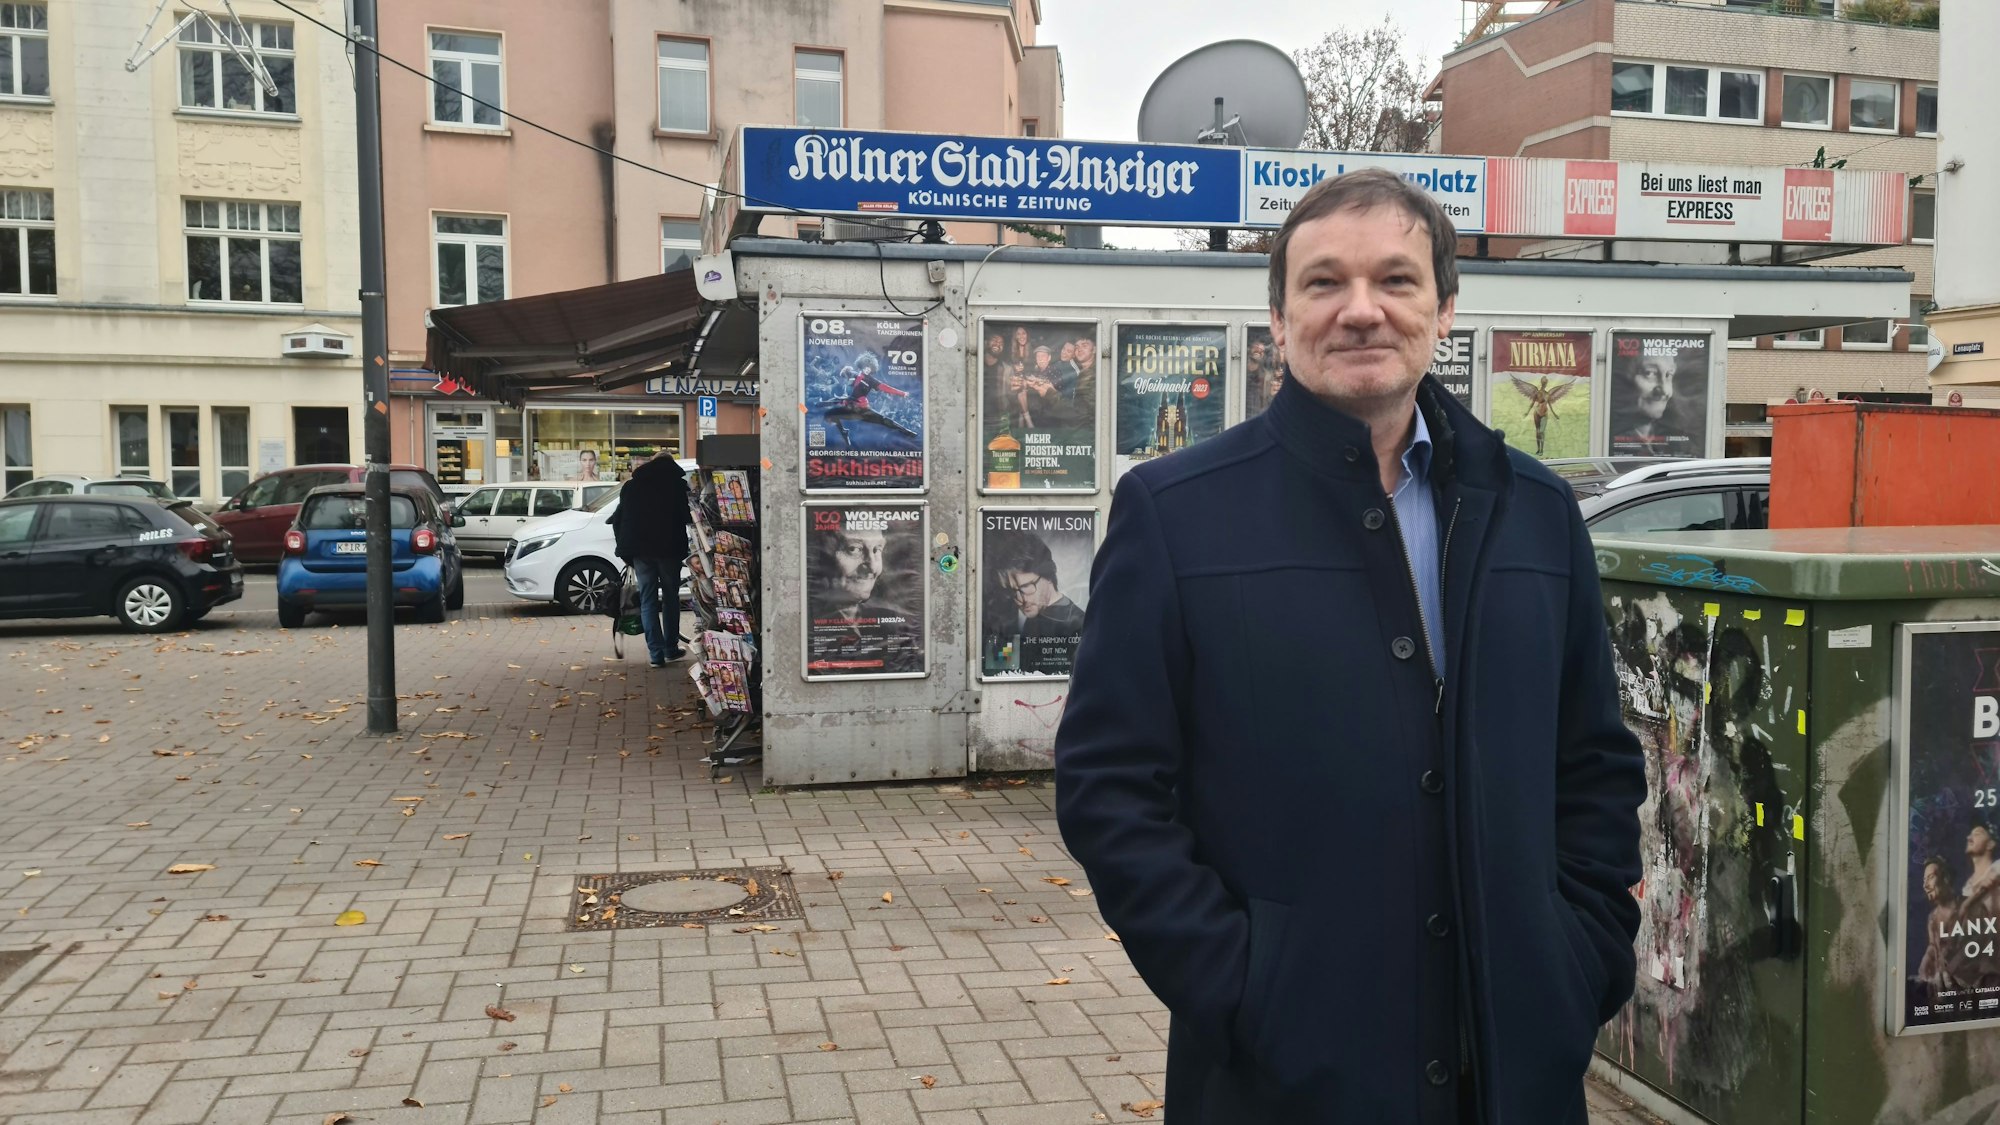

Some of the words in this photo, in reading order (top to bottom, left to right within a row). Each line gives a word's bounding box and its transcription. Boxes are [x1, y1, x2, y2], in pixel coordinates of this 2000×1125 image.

[789, 134, 927, 184] Kölner
[931, 140, 1199, 198] Stadt-Anzeiger
[1254, 160, 1326, 187] Kiosk
[1641, 172, 1663, 192] Bei
[1668, 177, 1692, 192] uns
[1697, 174, 1728, 194] liest
[1733, 179, 1762, 194] man
[908, 190, 1007, 208] KÖLNISCHE
[1017, 195, 1092, 211] ZEITUNG
[1567, 178, 1615, 215] EXPRESS
[1259, 197, 1298, 211] Zeitu
[1786, 185, 1832, 221] EXPRESS
[1667, 200, 1734, 220] EXPRESS
[810, 319, 851, 335] 08.
[877, 321, 900, 329] KÖLN
[877, 329, 923, 337] TANZBRUNNEN
[809, 338, 854, 346] NOVEMBER
[1643, 338, 1704, 348] WOLFGANG
[887, 350, 917, 365] 70
[1509, 342, 1577, 367] NIRVANA
[1643, 348, 1678, 357] NEUSS
[1127, 343, 1219, 376] HÖHNER
[1429, 363, 1469, 375] ÄUMEN
[1134, 377, 1192, 395] Weihnacht
[1193, 384, 1208, 392] 2023
[1025, 433, 1051, 444] MEHR
[1025, 445, 1064, 456] PROSTEN
[809, 458, 923, 477] Sukhishvili
[1024, 457, 1060, 468] POSTEN.
[813, 511, 841, 523] 100
[845, 511, 919, 521] WOLFGANG
[814, 523, 841, 531] JAHRE
[846, 520, 888, 531] NEUSS
[986, 516, 1038, 530] STEVEN
[1042, 517, 1092, 531] WILSON
[139, 527, 174, 542] MILES
[337, 543, 343, 552] K
[880, 616, 905, 624] 2023/24
[1038, 636, 1067, 644] HARMONY
